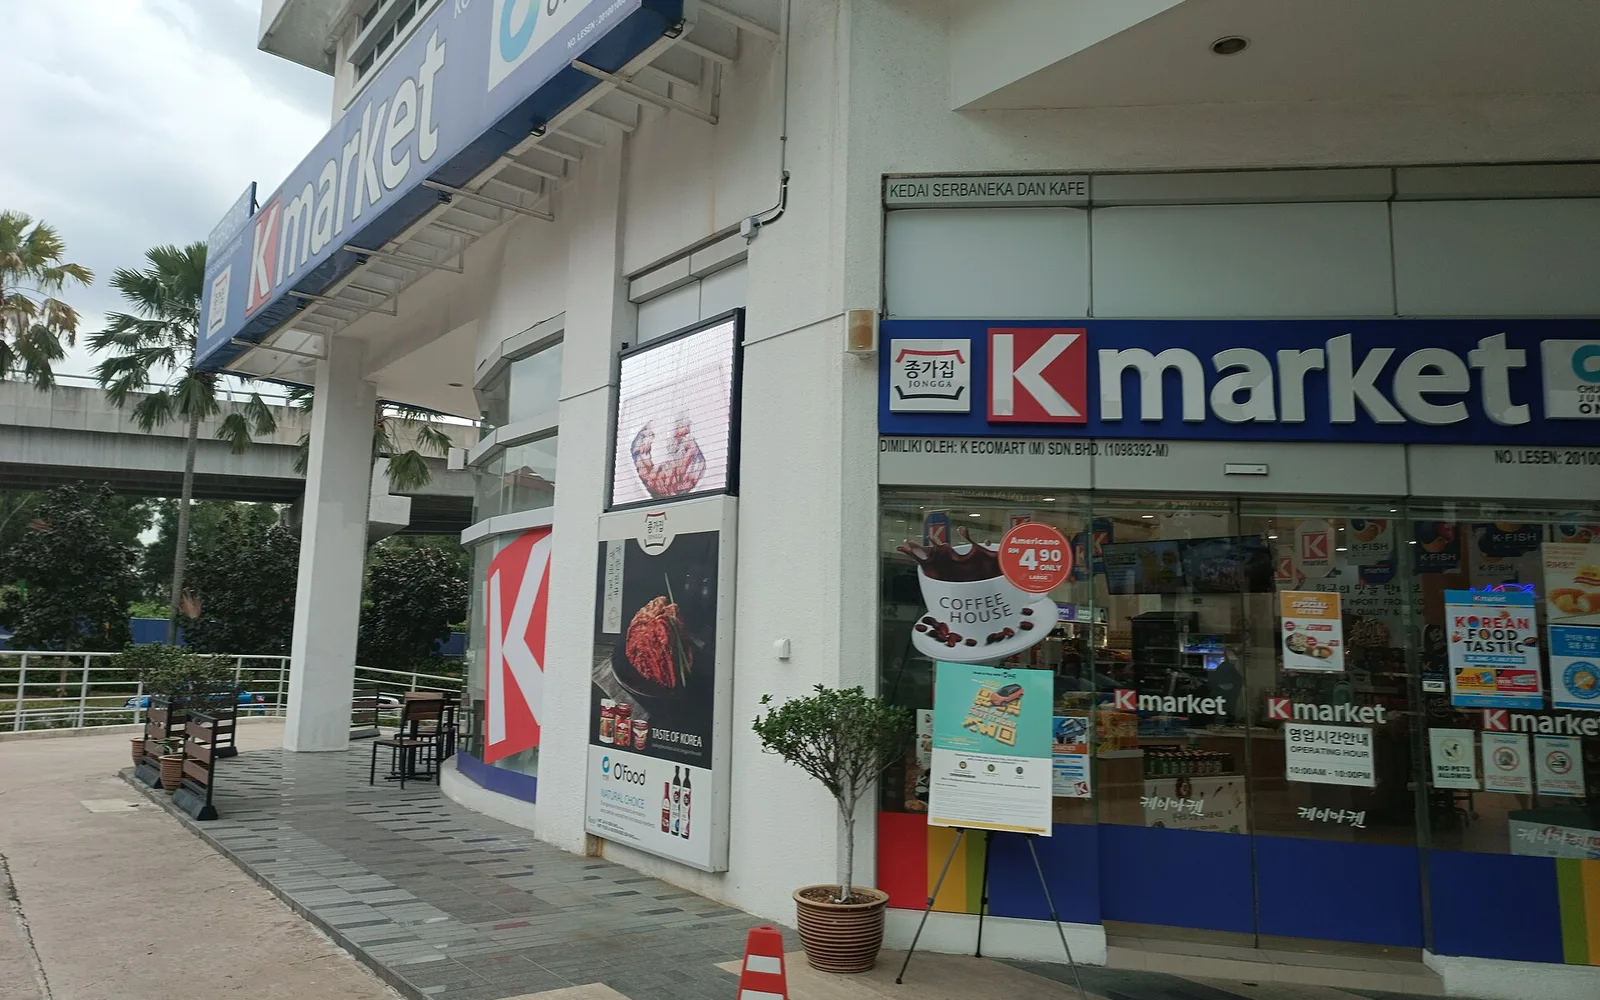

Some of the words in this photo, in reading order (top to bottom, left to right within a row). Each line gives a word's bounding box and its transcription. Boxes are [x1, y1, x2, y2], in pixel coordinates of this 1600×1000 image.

[890, 183, 930, 198] KEDAI
[932, 182, 1014, 197] SERBANEKA
[1017, 181, 1046, 196] DAN
[1049, 181, 1085, 196] KAFE
[903, 359, 955, 379] 종가집
[908, 380, 953, 388] JONGGA
[880, 439, 924, 454] DIMILIKI
[925, 440, 958, 454] OLEH:
[960, 441, 969, 454] K
[971, 441, 1026, 455] ECOMART
[1028, 441, 1045, 456] (M)
[1104, 443, 1169, 457] (1098392-M)
[1494, 450, 1517, 464] NO.
[1519, 450, 1562, 464] LESEN:
[1009, 536, 1060, 547] Americano
[1039, 564, 1062, 572] ONLY
[939, 592, 1005, 611] COFFEE
[950, 605, 1014, 624] HOUSE
[1454, 615, 1530, 630] KOREAN
[1468, 628, 1518, 641] FOOD
[1464, 640, 1526, 654] TASTIC
[1510, 713, 1600, 736] marke
[652, 727, 670, 743] TASTE
[670, 732, 680, 744] OF
[680, 733, 703, 748] KOREA
[1289, 728, 1369, 747] 영업시간안내
[1290, 745, 1341, 757] OPERATING
[1342, 748, 1370, 758] HOUR
[1450, 765, 1471, 773] PETS
[600, 788, 625, 805] NATURAL
